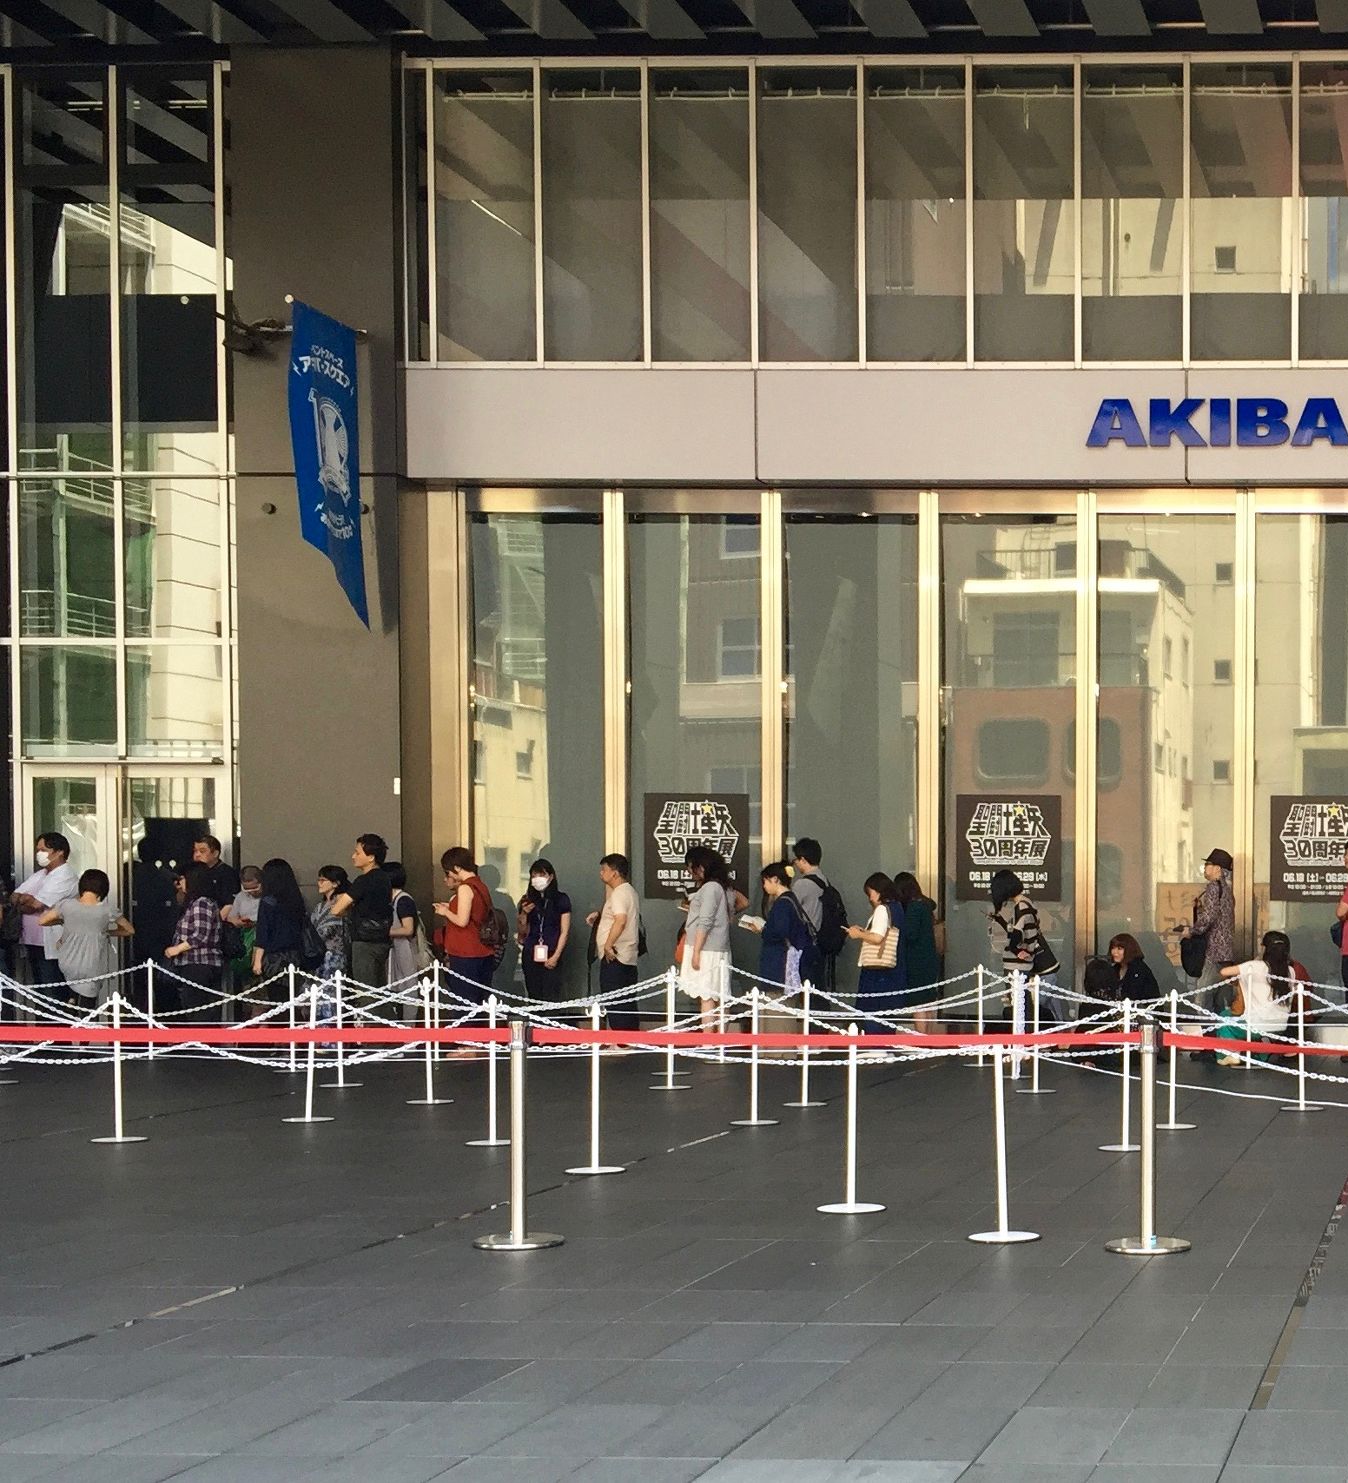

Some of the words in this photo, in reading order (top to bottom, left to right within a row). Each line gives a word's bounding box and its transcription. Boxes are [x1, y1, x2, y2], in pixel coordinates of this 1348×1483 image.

[968, 838, 1050, 860] 30周年展
[1282, 839, 1346, 860] 30周年
[1013, 871, 1035, 881] 6.29
